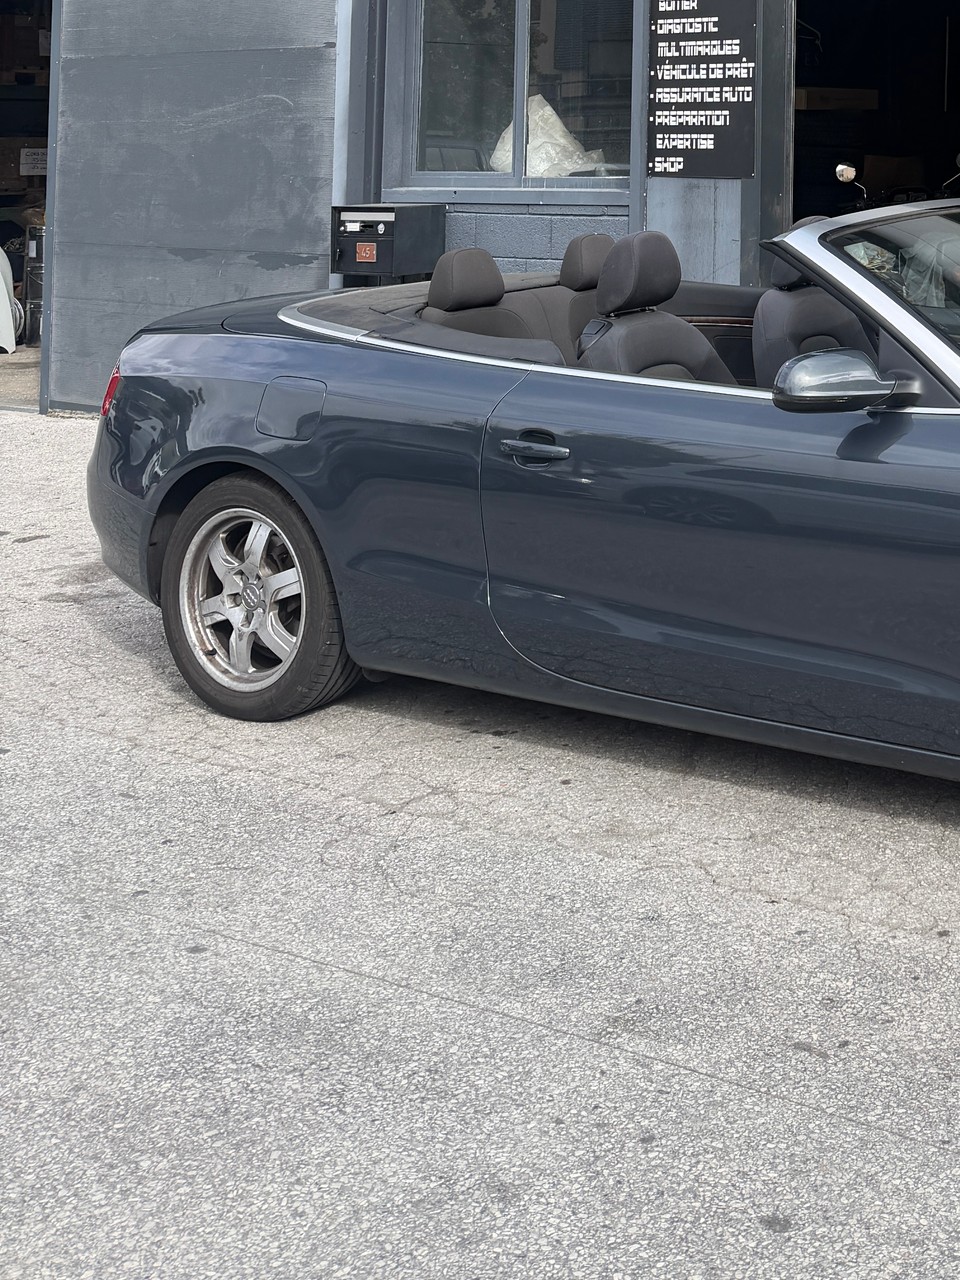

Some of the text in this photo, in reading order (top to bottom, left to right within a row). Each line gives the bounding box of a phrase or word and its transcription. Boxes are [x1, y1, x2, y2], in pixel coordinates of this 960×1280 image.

[657, 16, 719, 34] DIAGNOSTIC
[657, 39, 740, 57] MULTIMARQUES
[656, 57, 755, 80] VÉHICULE DE PRÊT
[655, 86, 753, 103] ASSURANCE AUTO
[655, 105, 730, 126] PRÉPARATION
[656, 133, 715, 150] EXPERTISE
[654, 156, 684, 173] SHOP
